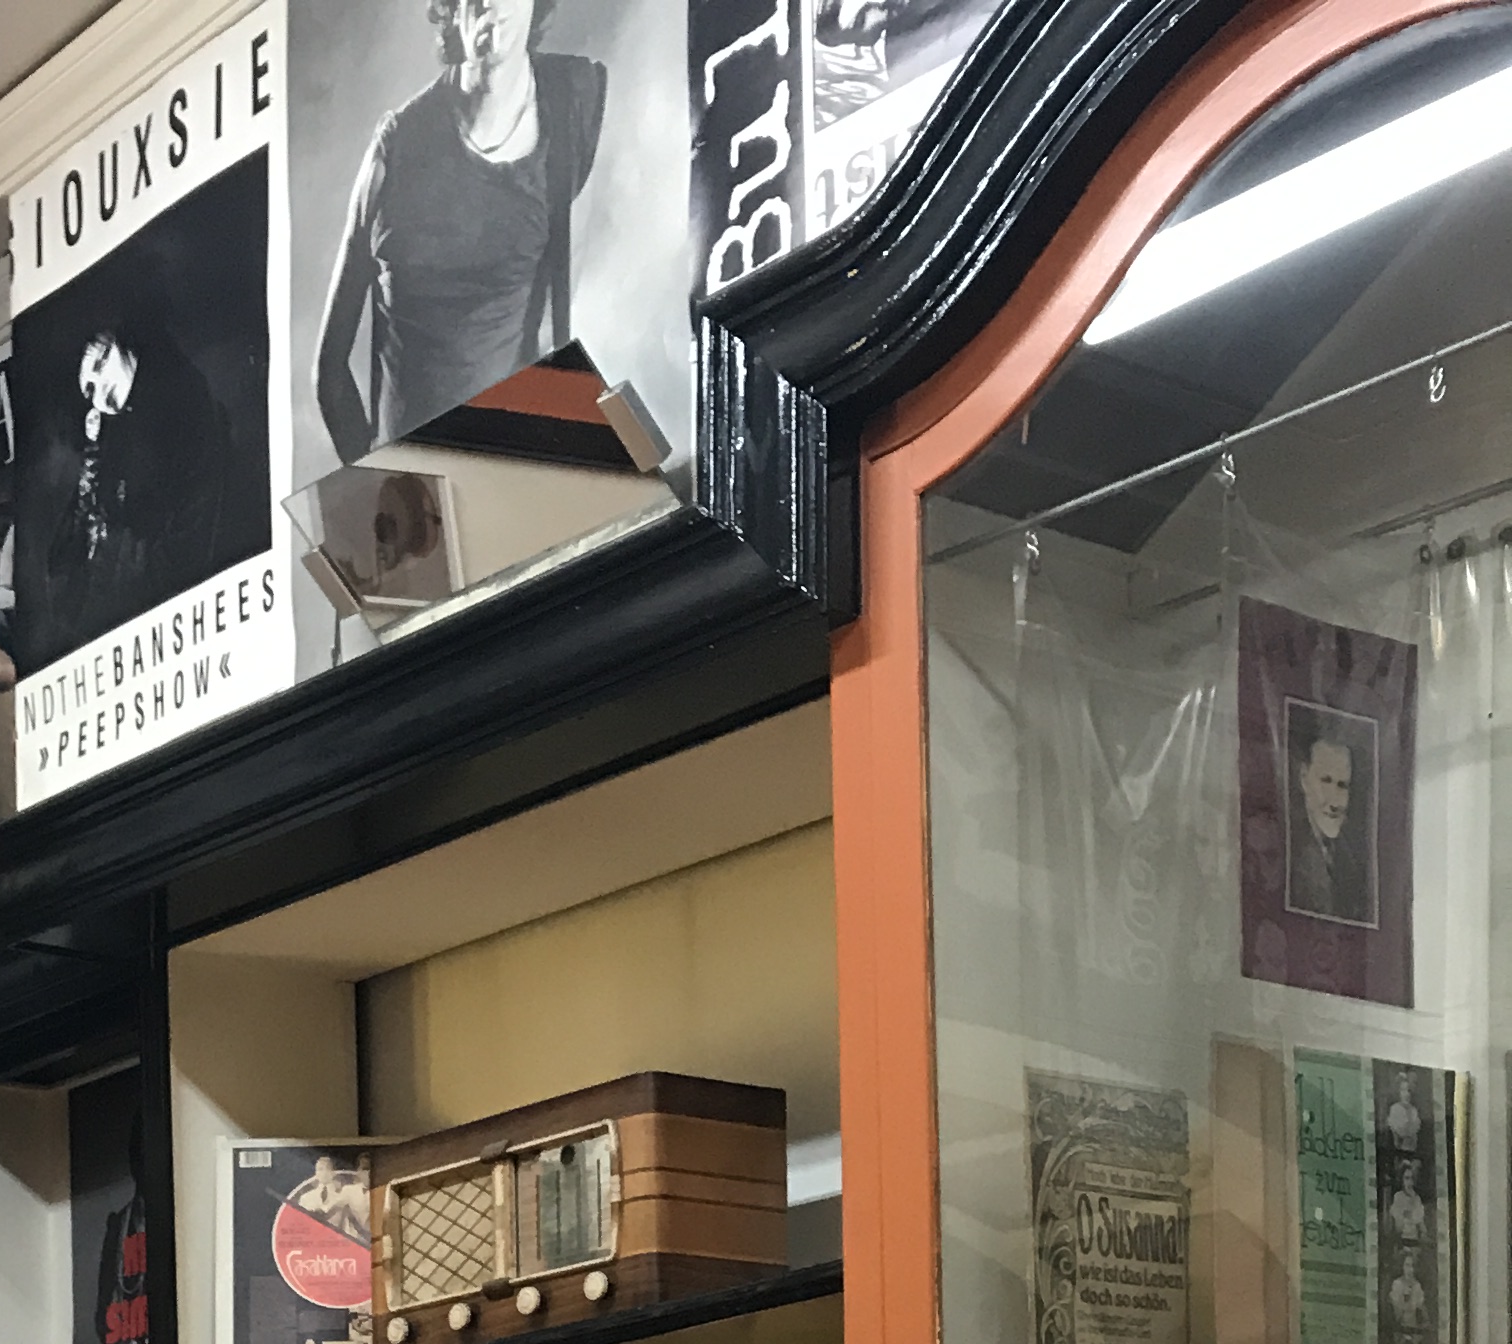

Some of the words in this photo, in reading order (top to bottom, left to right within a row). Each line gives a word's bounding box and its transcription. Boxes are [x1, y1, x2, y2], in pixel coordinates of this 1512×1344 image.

[1076, 1193, 1094, 1255] O
[1079, 1260, 1102, 1281] wie
[1119, 1264, 1143, 1286] das
[1144, 1267, 1185, 1290] Leben
[1079, 1286, 1114, 1307] doch
[1115, 1292, 1132, 1308] so
